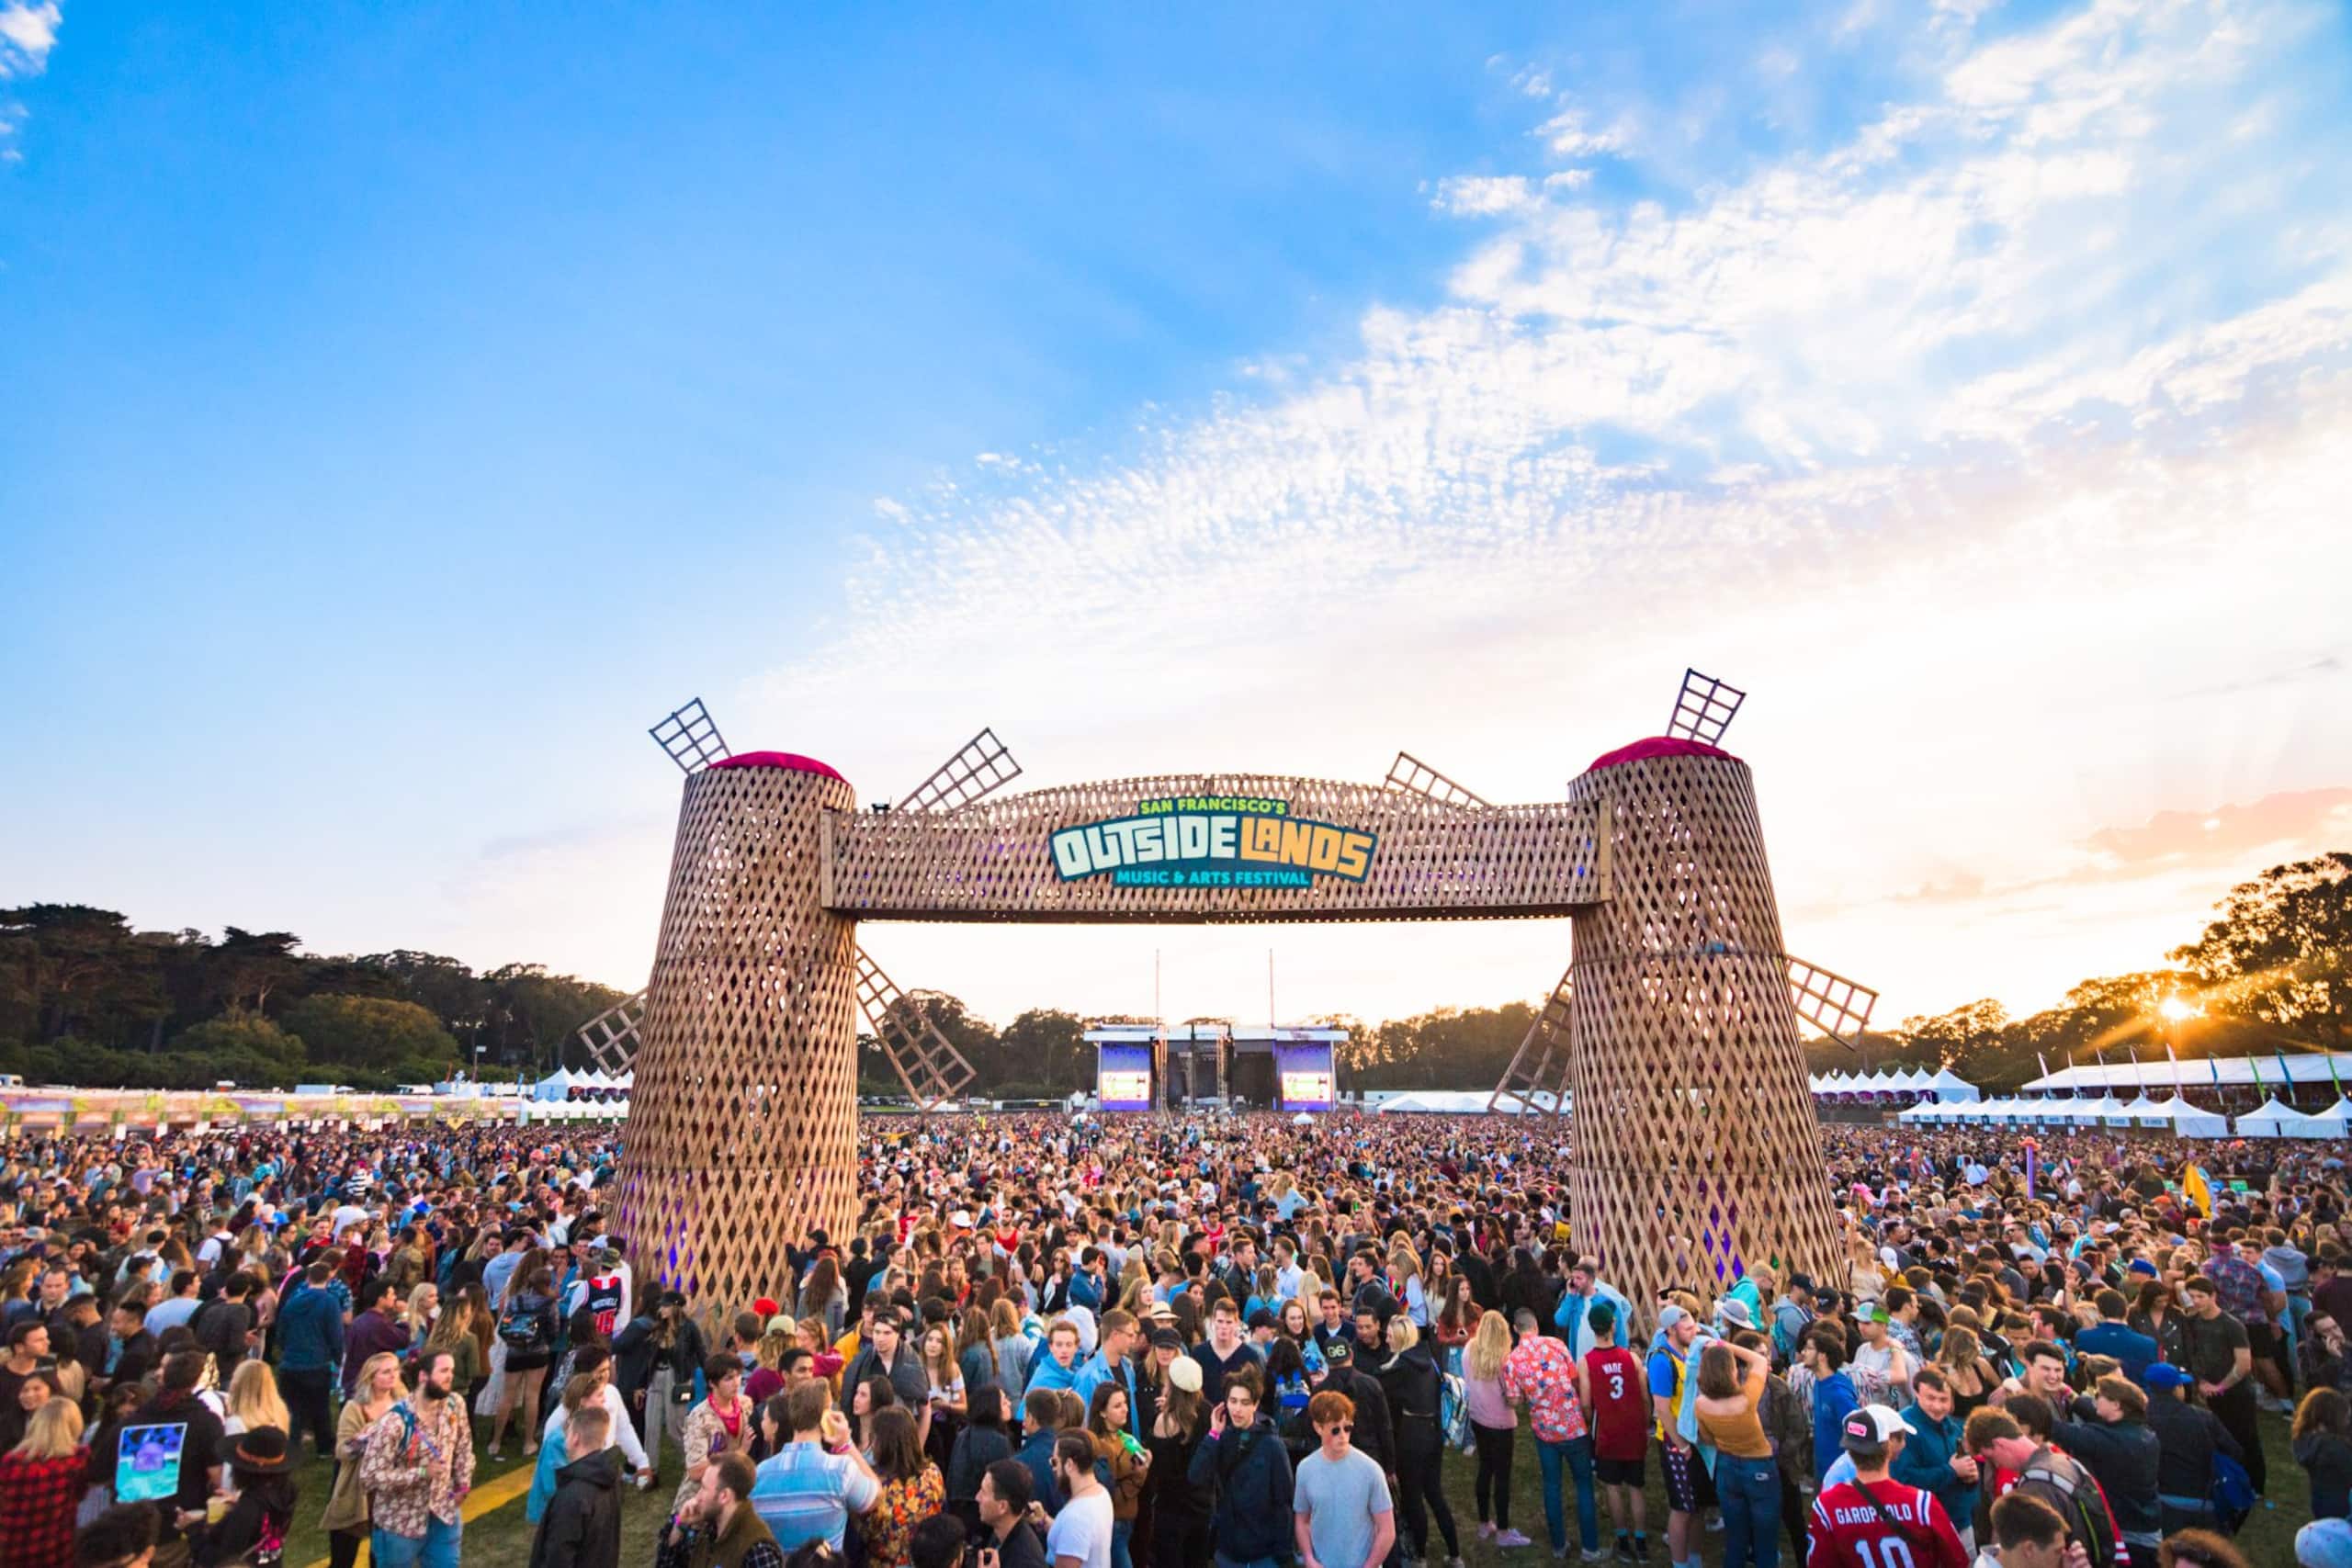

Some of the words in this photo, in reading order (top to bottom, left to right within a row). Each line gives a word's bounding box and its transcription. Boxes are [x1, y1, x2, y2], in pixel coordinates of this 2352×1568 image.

[1140, 801, 1173, 815] SAN
[1178, 798, 1286, 815] FRANCISCO'S
[1053, 816, 1238, 877] OUTSIDE
[1240, 817, 1374, 878] LANDS
[1117, 871, 1169, 884] MUSIC
[1173, 871, 1185, 884] &
[1189, 871, 1231, 884] ARTS
[1236, 871, 1309, 885] FESTIVAL
[1601, 1362, 1623, 1374] WADE
[1610, 1375, 1623, 1399] 3
[1835, 1503, 1913, 1525] GAROPOLO
[1855, 1536, 1917, 1568] 10
